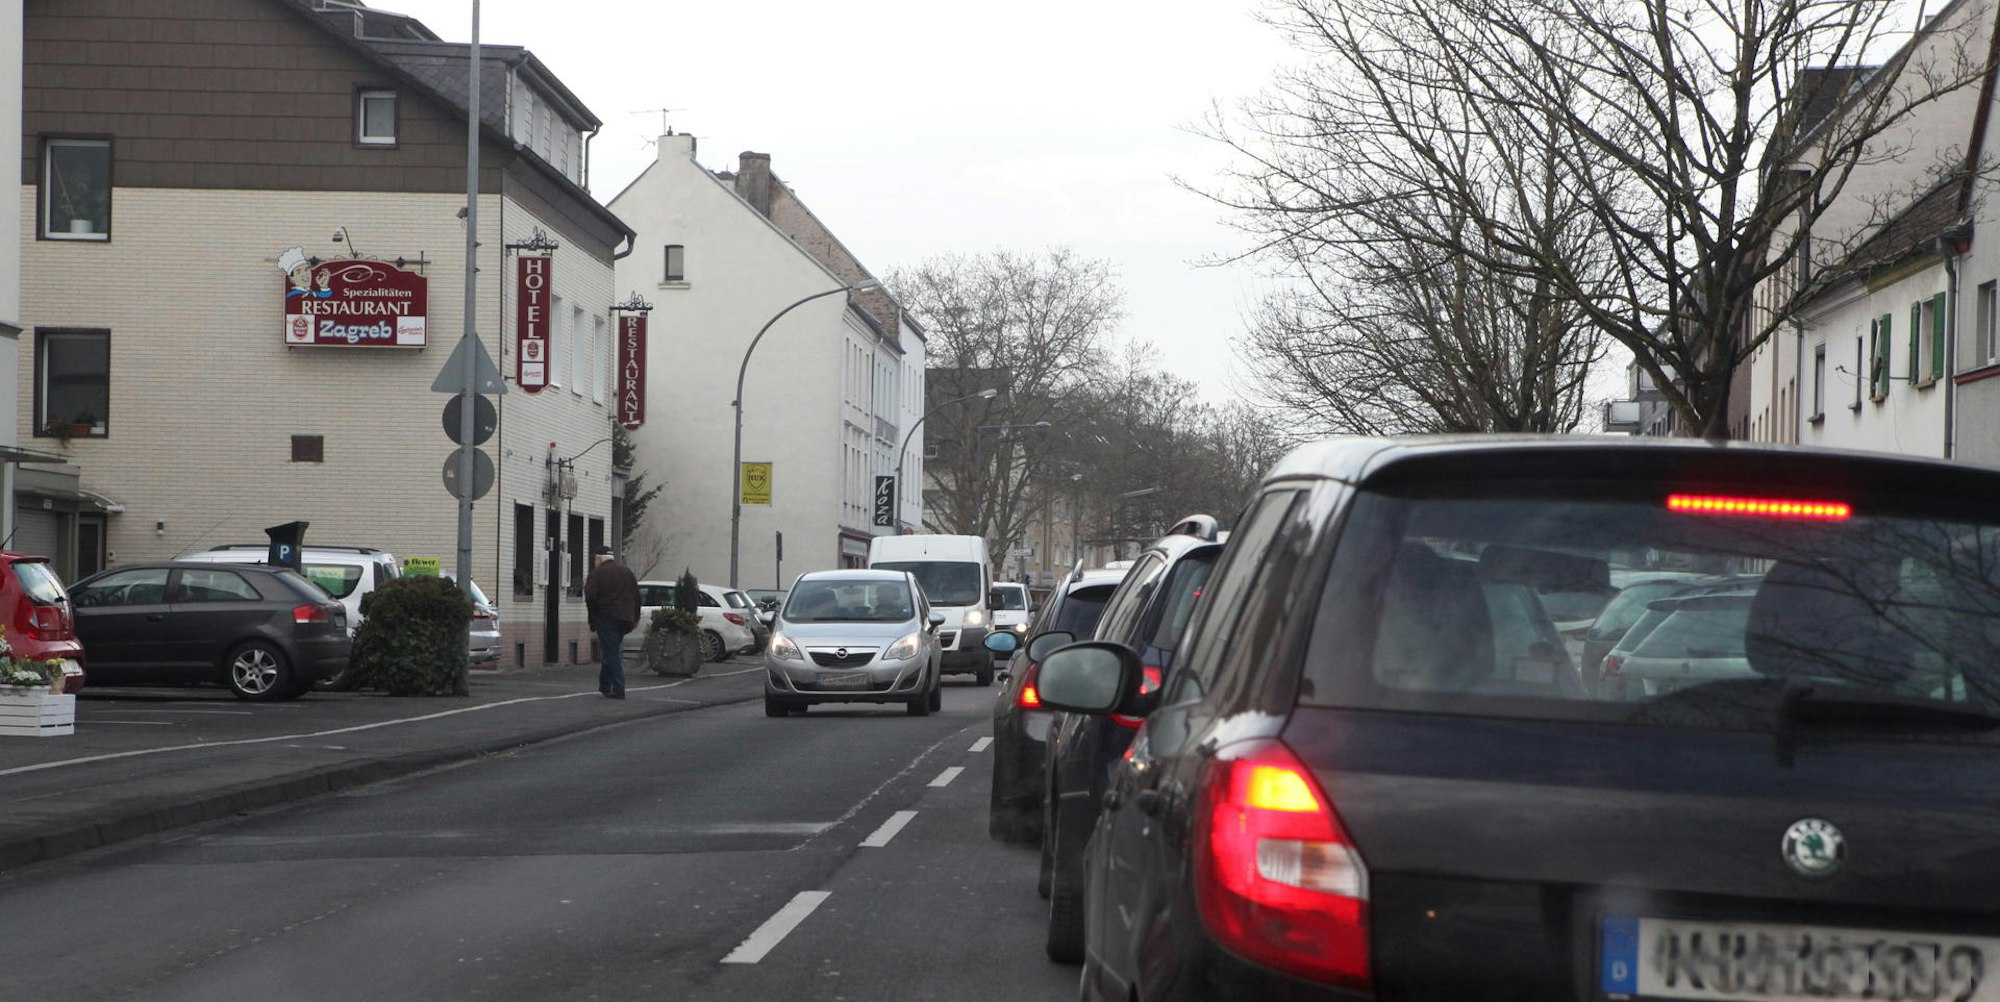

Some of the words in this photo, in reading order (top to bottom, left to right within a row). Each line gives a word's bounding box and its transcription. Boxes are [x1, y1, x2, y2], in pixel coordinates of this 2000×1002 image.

[343, 287, 412, 299] Spezialitäten
[525, 259, 544, 339] HOTEL
[301, 300, 412, 316] RESTAURANT
[318, 319, 393, 344] Zagreb
[625, 317, 639, 422] RESTAURANT
[877, 477, 893, 525] Koza
[280, 545, 290, 560] P
